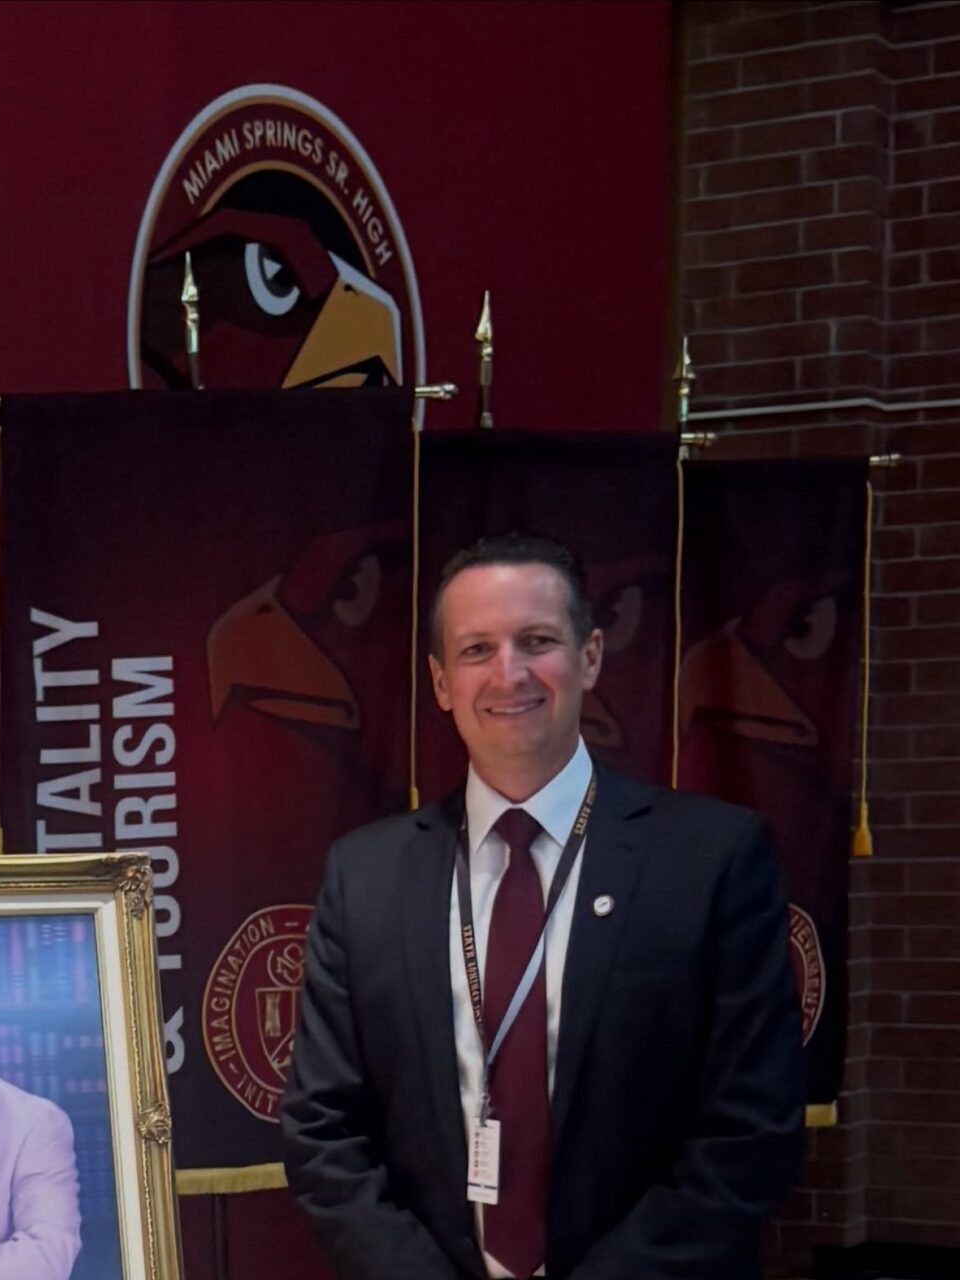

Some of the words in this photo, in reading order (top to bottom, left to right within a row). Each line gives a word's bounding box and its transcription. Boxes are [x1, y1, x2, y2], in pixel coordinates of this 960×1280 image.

[182, 129, 240, 204] MIAMI
[243, 119, 324, 165] SPRINGS
[326, 151, 349, 195] SR.
[352, 188, 392, 265] HIGH
[211, 915, 275, 1062] IMAGINATION
